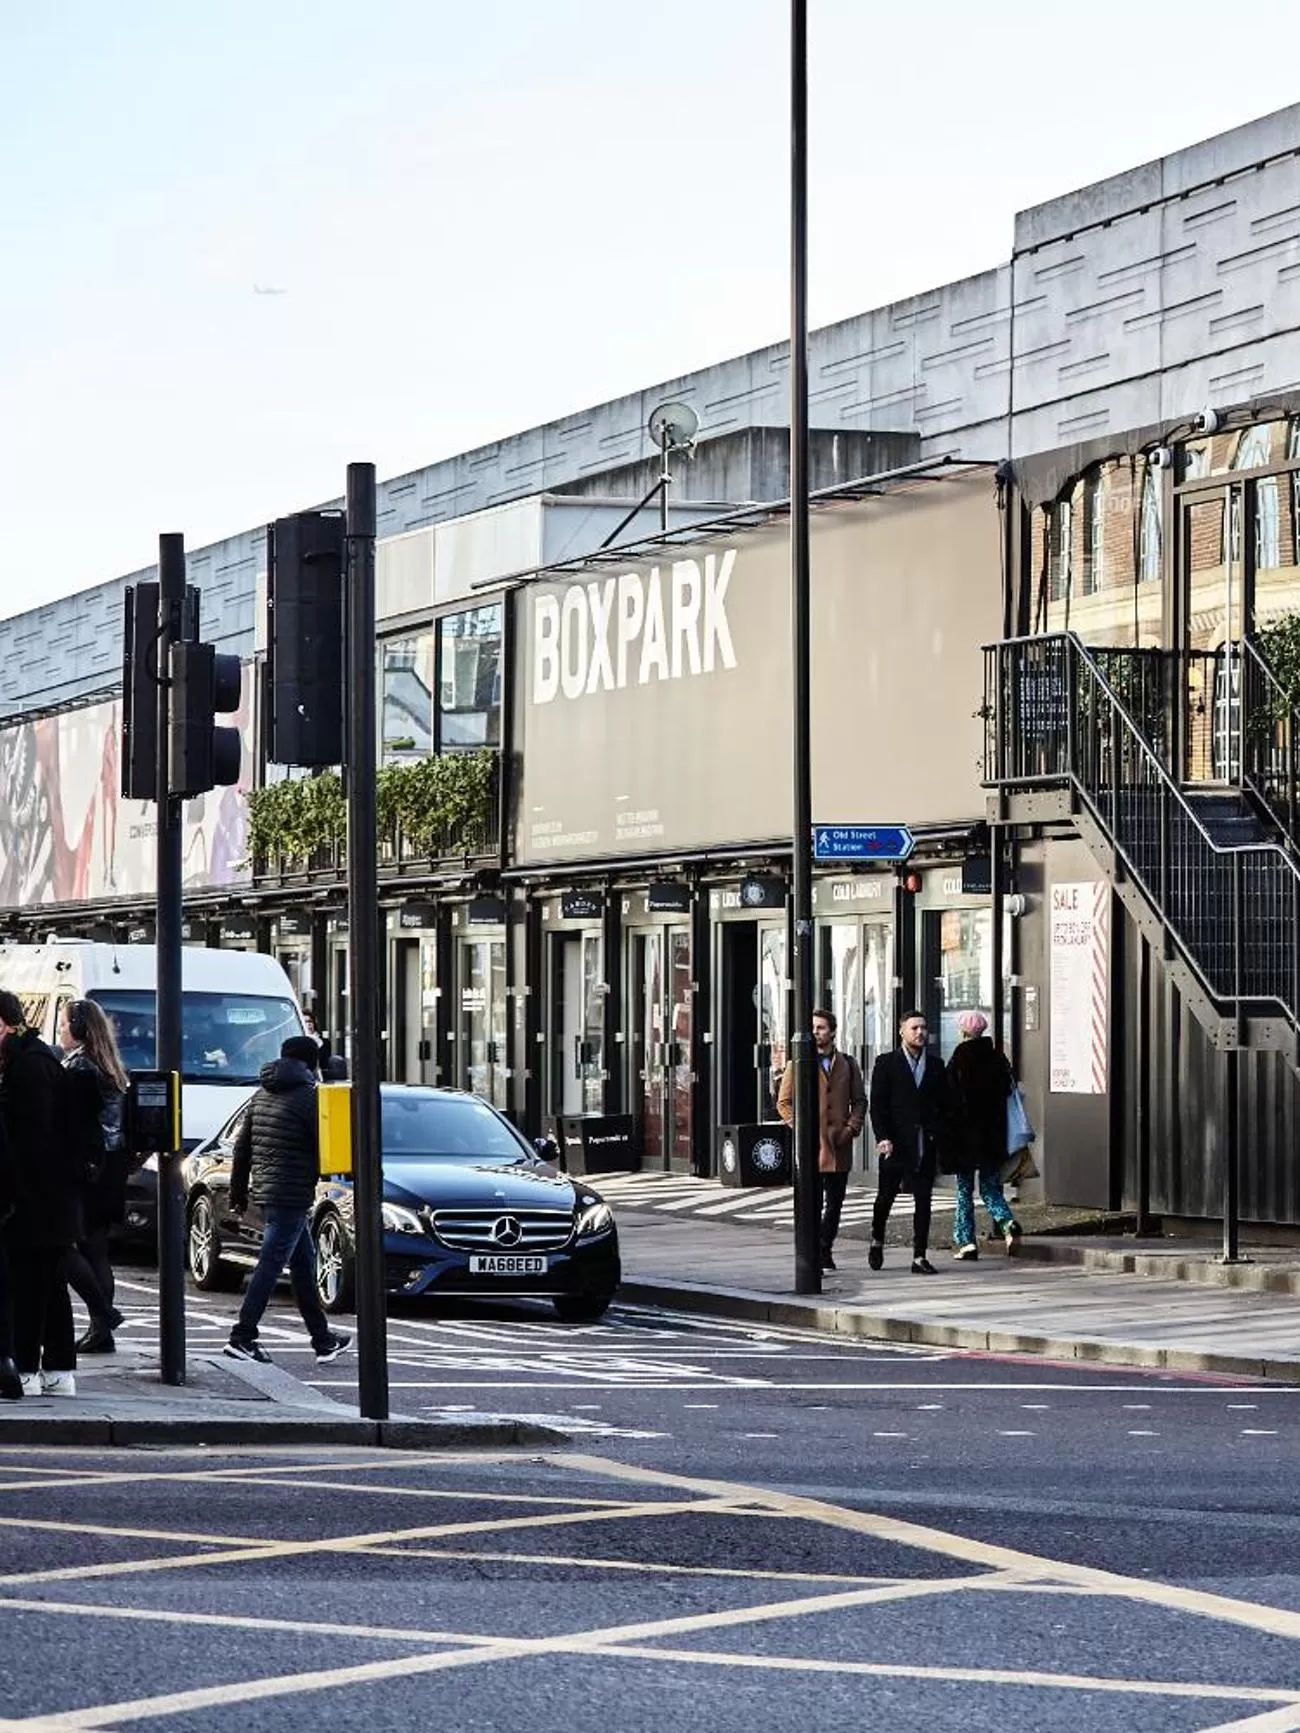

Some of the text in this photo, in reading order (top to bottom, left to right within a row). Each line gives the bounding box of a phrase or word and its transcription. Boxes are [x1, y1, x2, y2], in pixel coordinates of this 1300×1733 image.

[533, 549, 738, 705] BOXPARK
[833, 831, 876, 840] Old Street
[833, 843, 863, 851] Station
[1053, 888, 1078, 910] SALE
[478, 1257, 543, 1271] WA68EED
